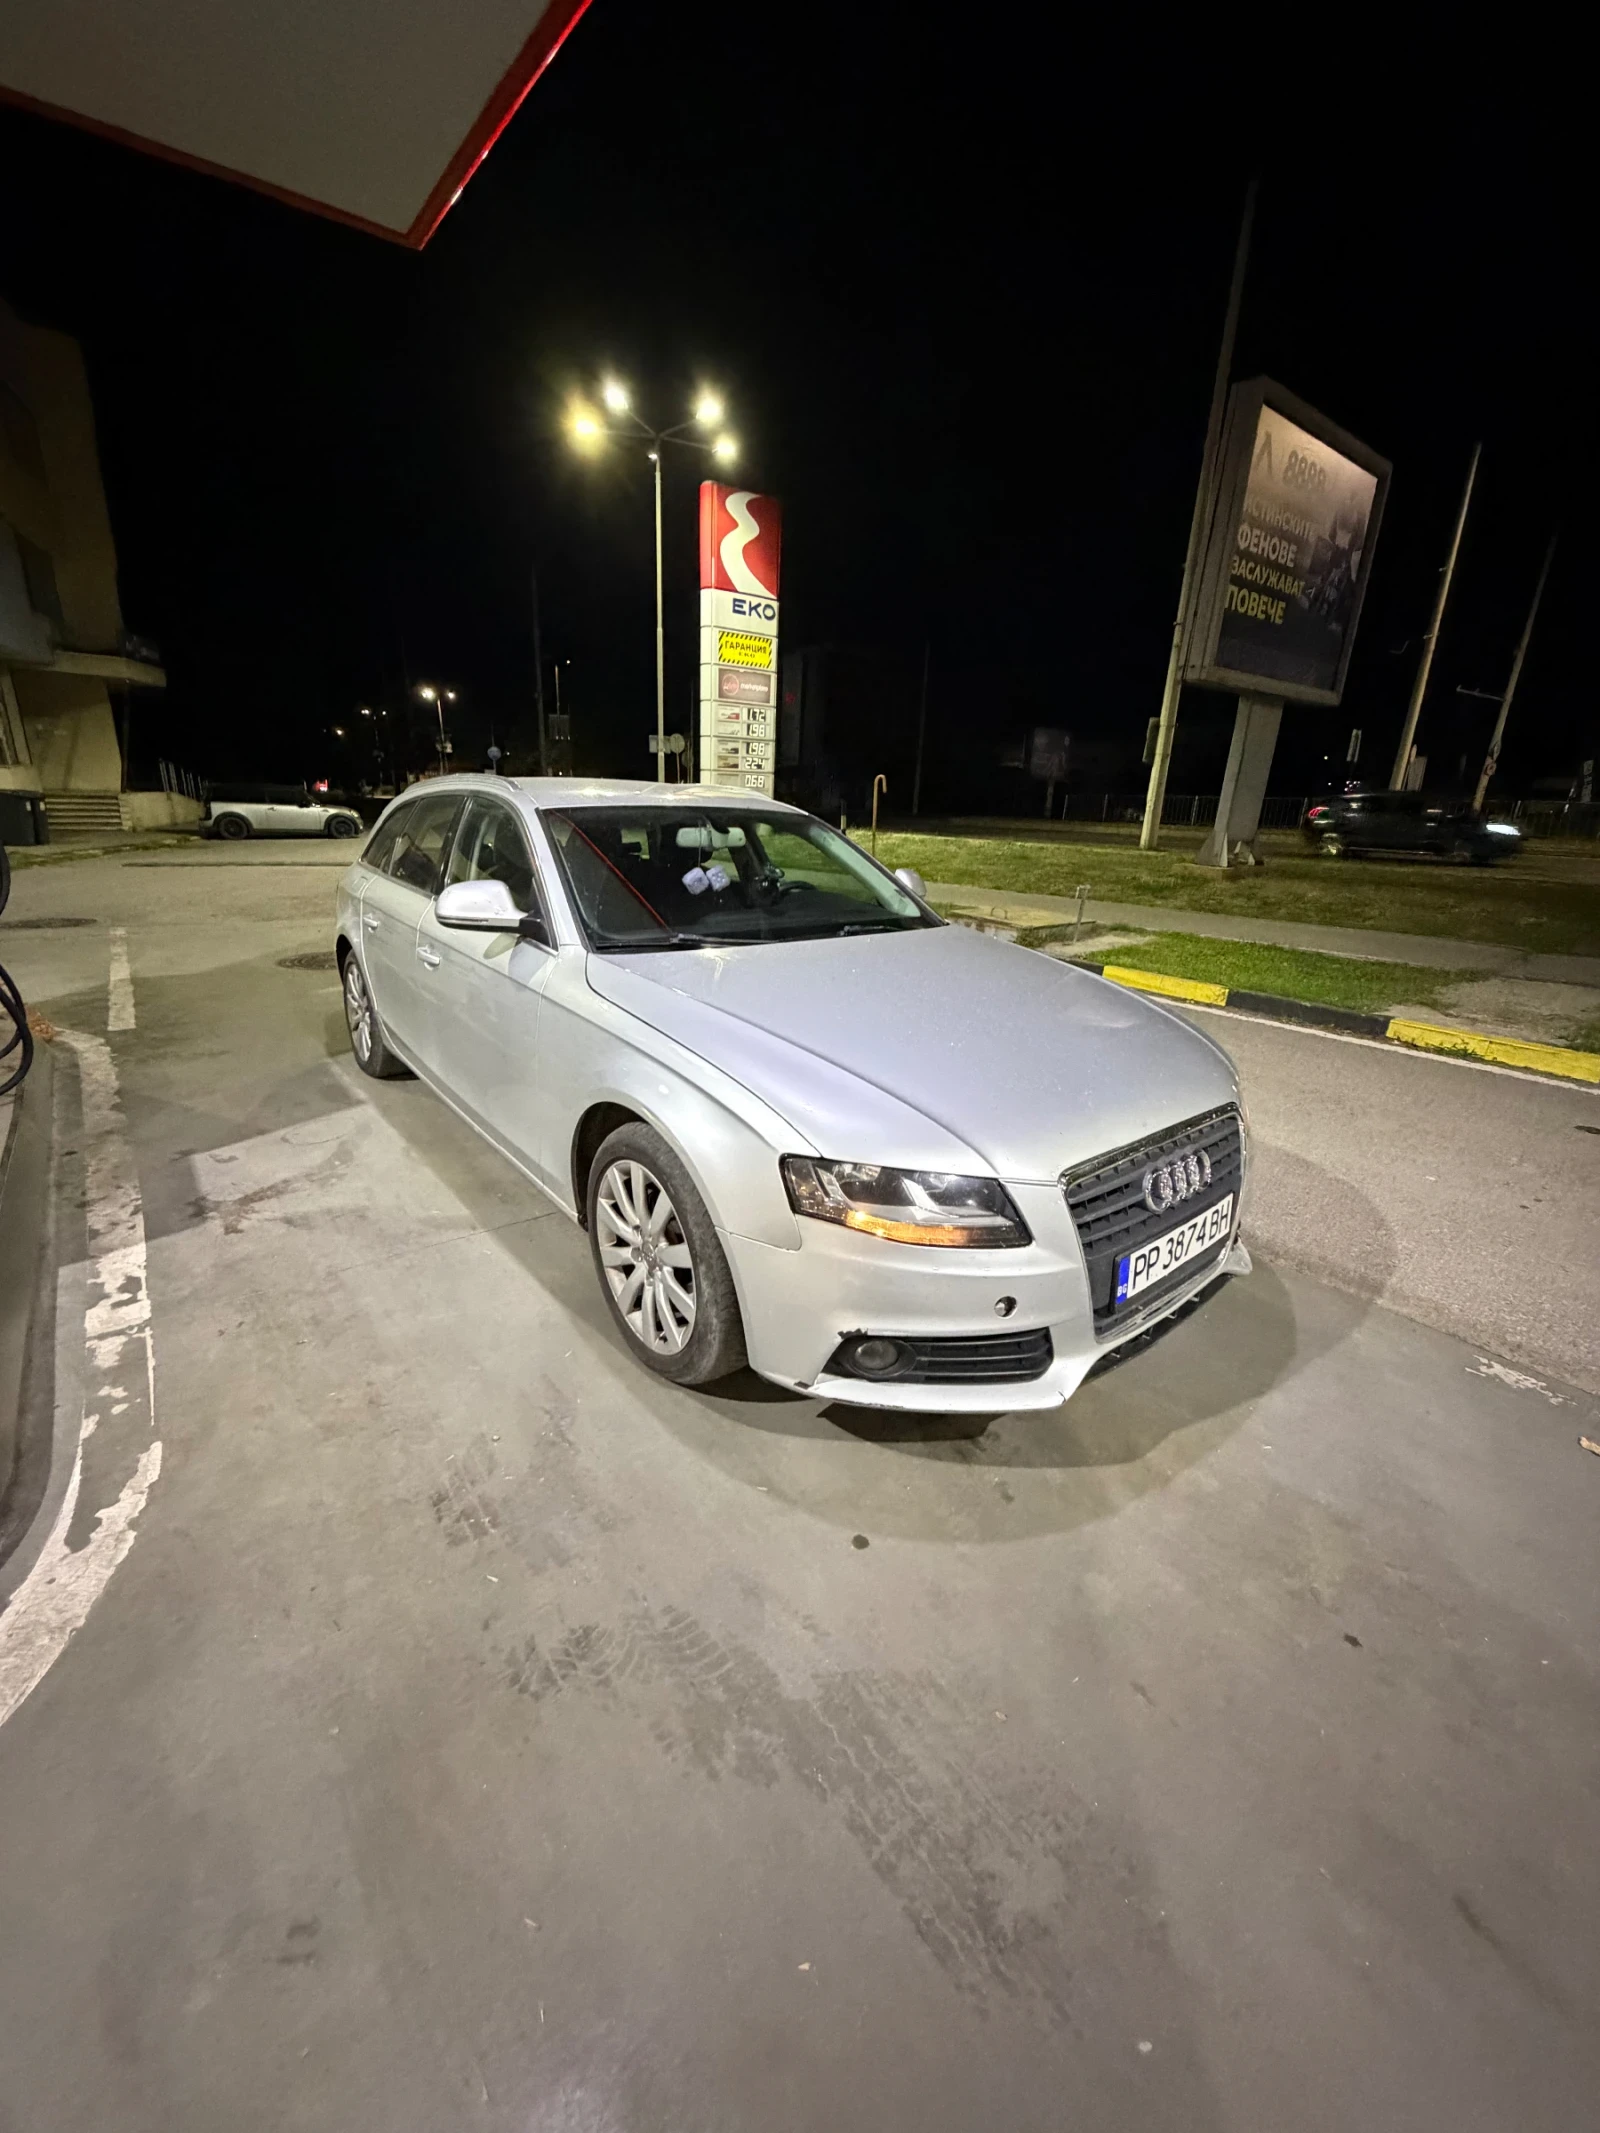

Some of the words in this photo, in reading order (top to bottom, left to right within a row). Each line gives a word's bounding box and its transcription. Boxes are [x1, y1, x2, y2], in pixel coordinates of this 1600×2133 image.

[1238, 523, 1298, 568] ФЕНОВЕ
[1231, 554, 1306, 598] ЗАСЛУЖАВАТ
[732, 598, 776, 621] EKO
[1225, 585, 1286, 625] ПОВЕЧЕ
[724, 641, 767, 654] ГАРАНЦИЯ
[1132, 1246, 1160, 1289] PP
[1162, 1216, 1208, 1270] 3874
[1209, 1200, 1231, 1240] BH
[1117, 1283, 1128, 1296] BG
